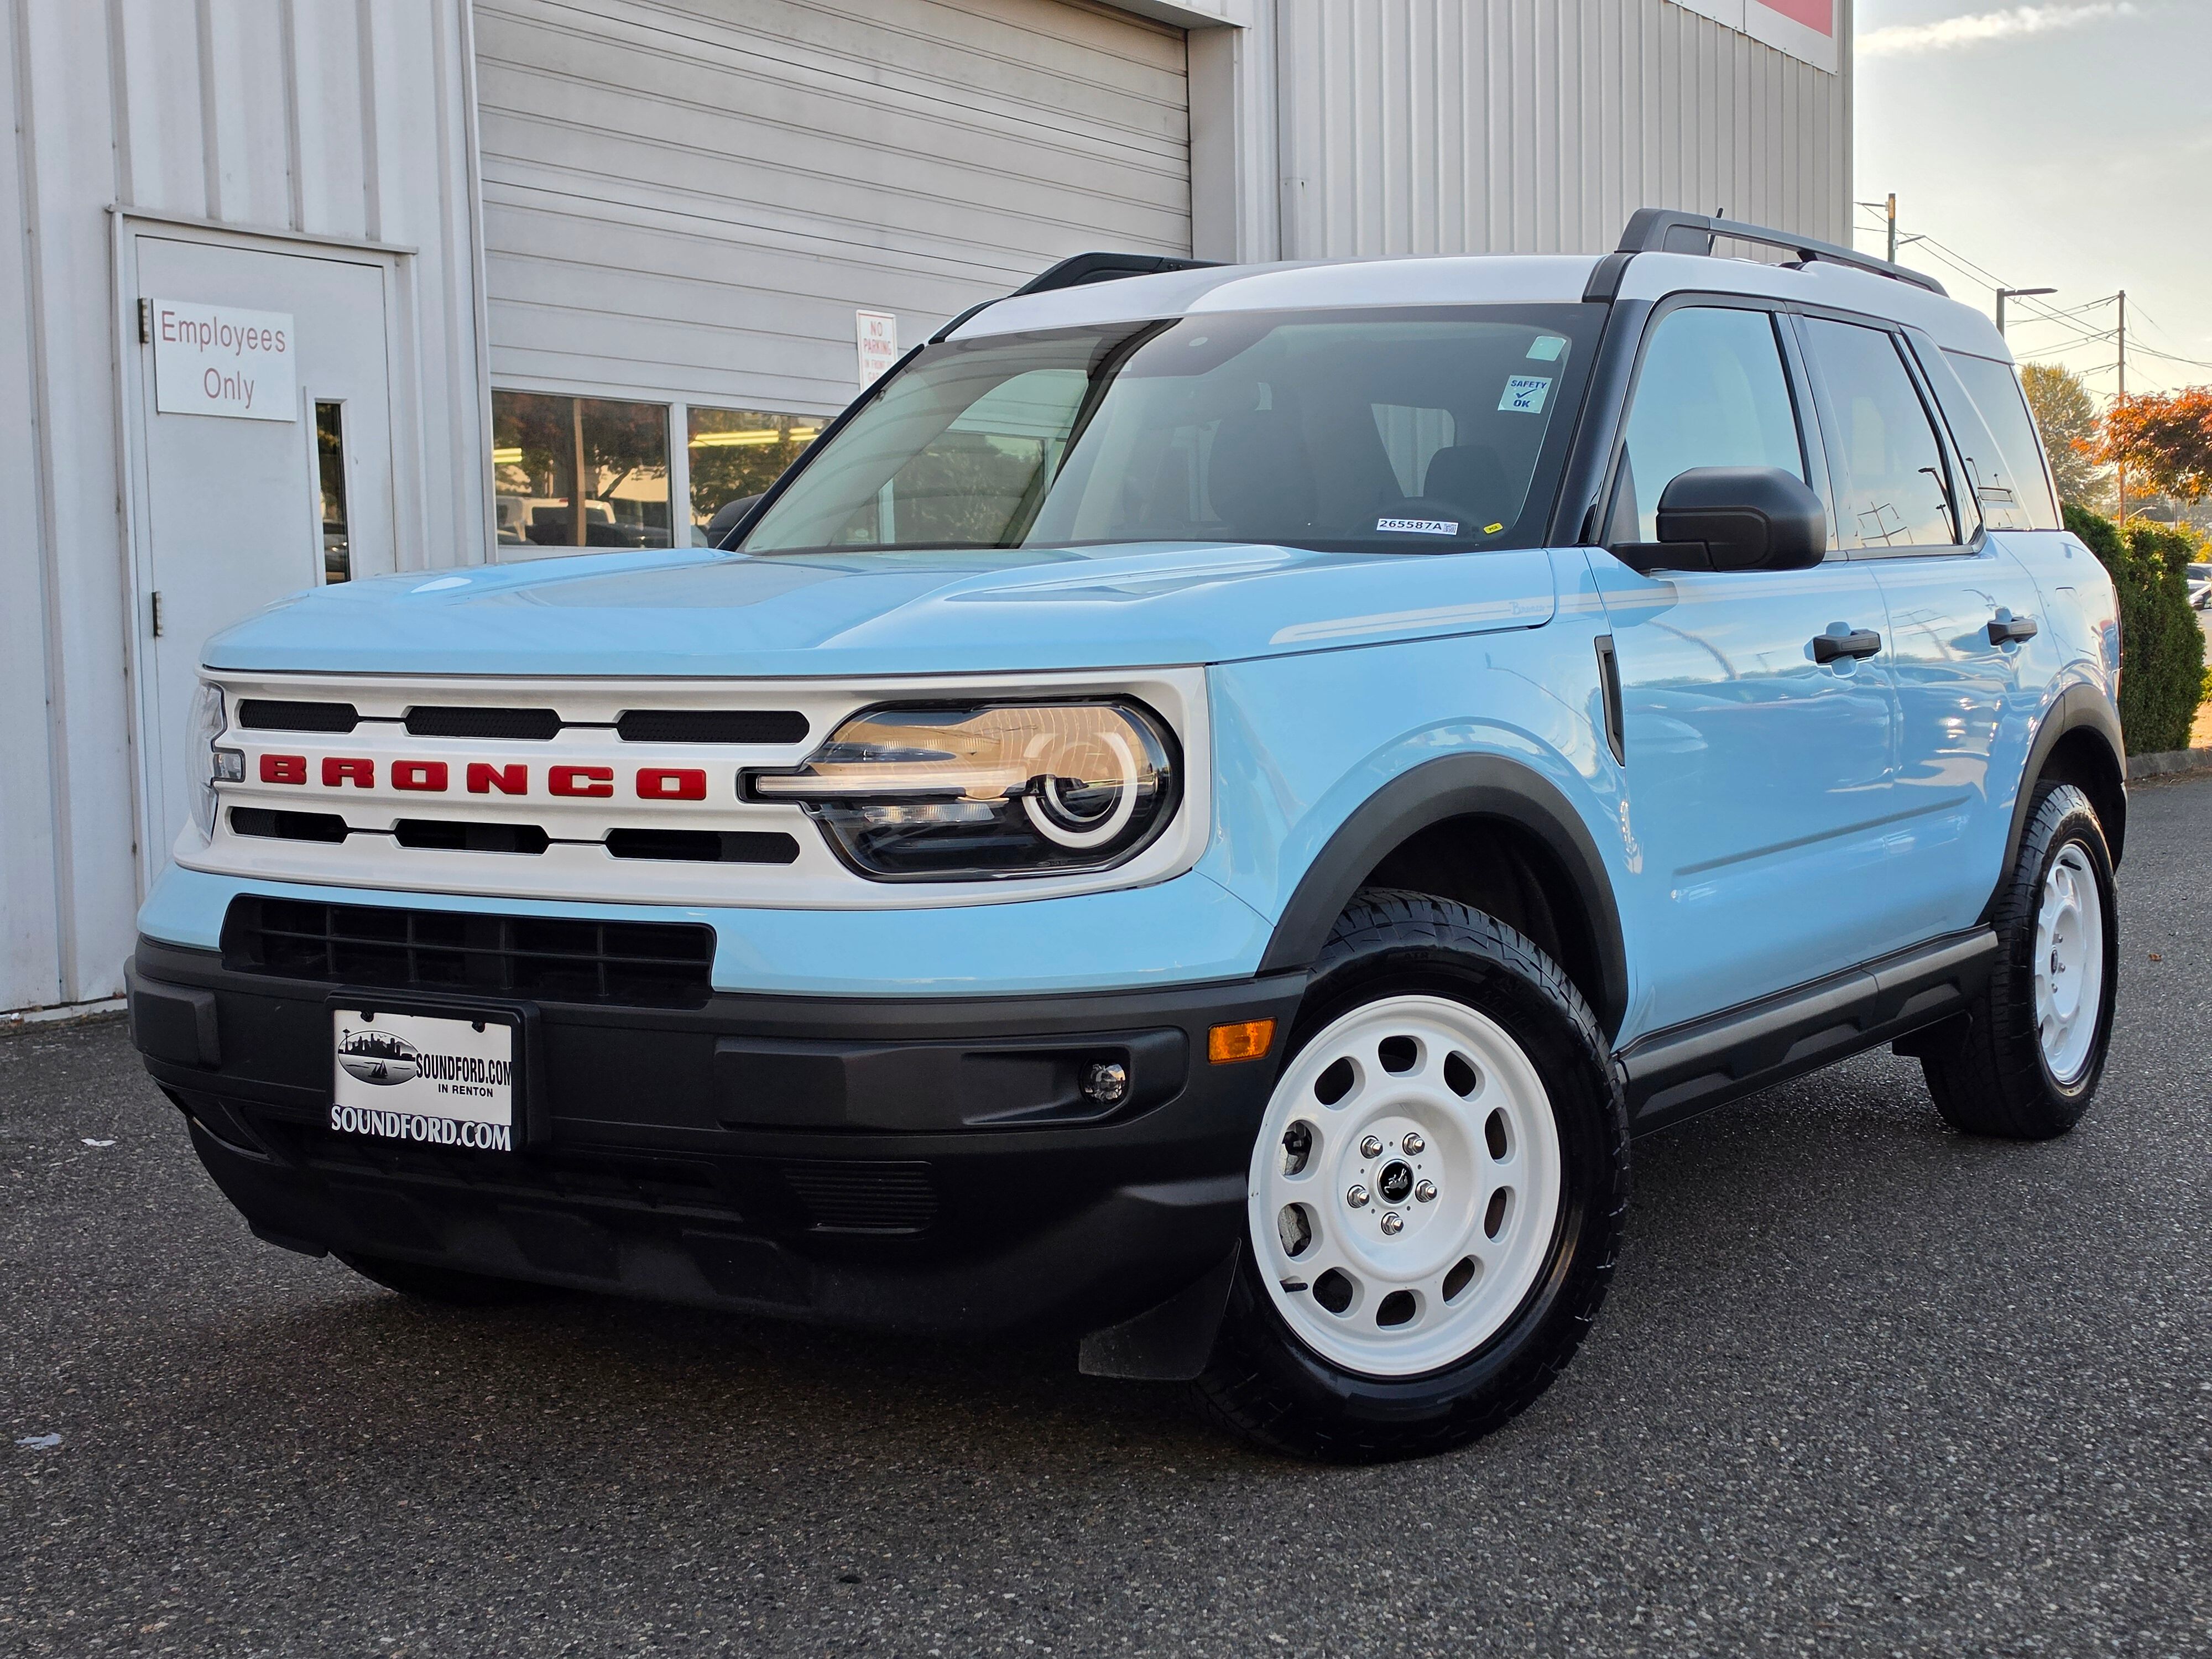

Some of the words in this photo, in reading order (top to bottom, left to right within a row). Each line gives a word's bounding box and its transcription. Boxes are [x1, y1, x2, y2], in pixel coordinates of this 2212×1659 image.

[161, 310, 286, 356] Employees
[870, 321, 883, 337] NO
[863, 337, 892, 356] PARKING
[204, 367, 255, 409] Only
[1511, 379, 1547, 389] SAFETY
[1513, 399, 1531, 408] OK
[1379, 520, 1442, 530] 265587A
[259, 754, 707, 801] BRONCO
[415, 1053, 512, 1086] SOUNDFORD.COM
[438, 1083, 448, 1094] IN
[452, 1084, 493, 1098] RENTON
[331, 1105, 512, 1152] SOUNDFORD.COM
